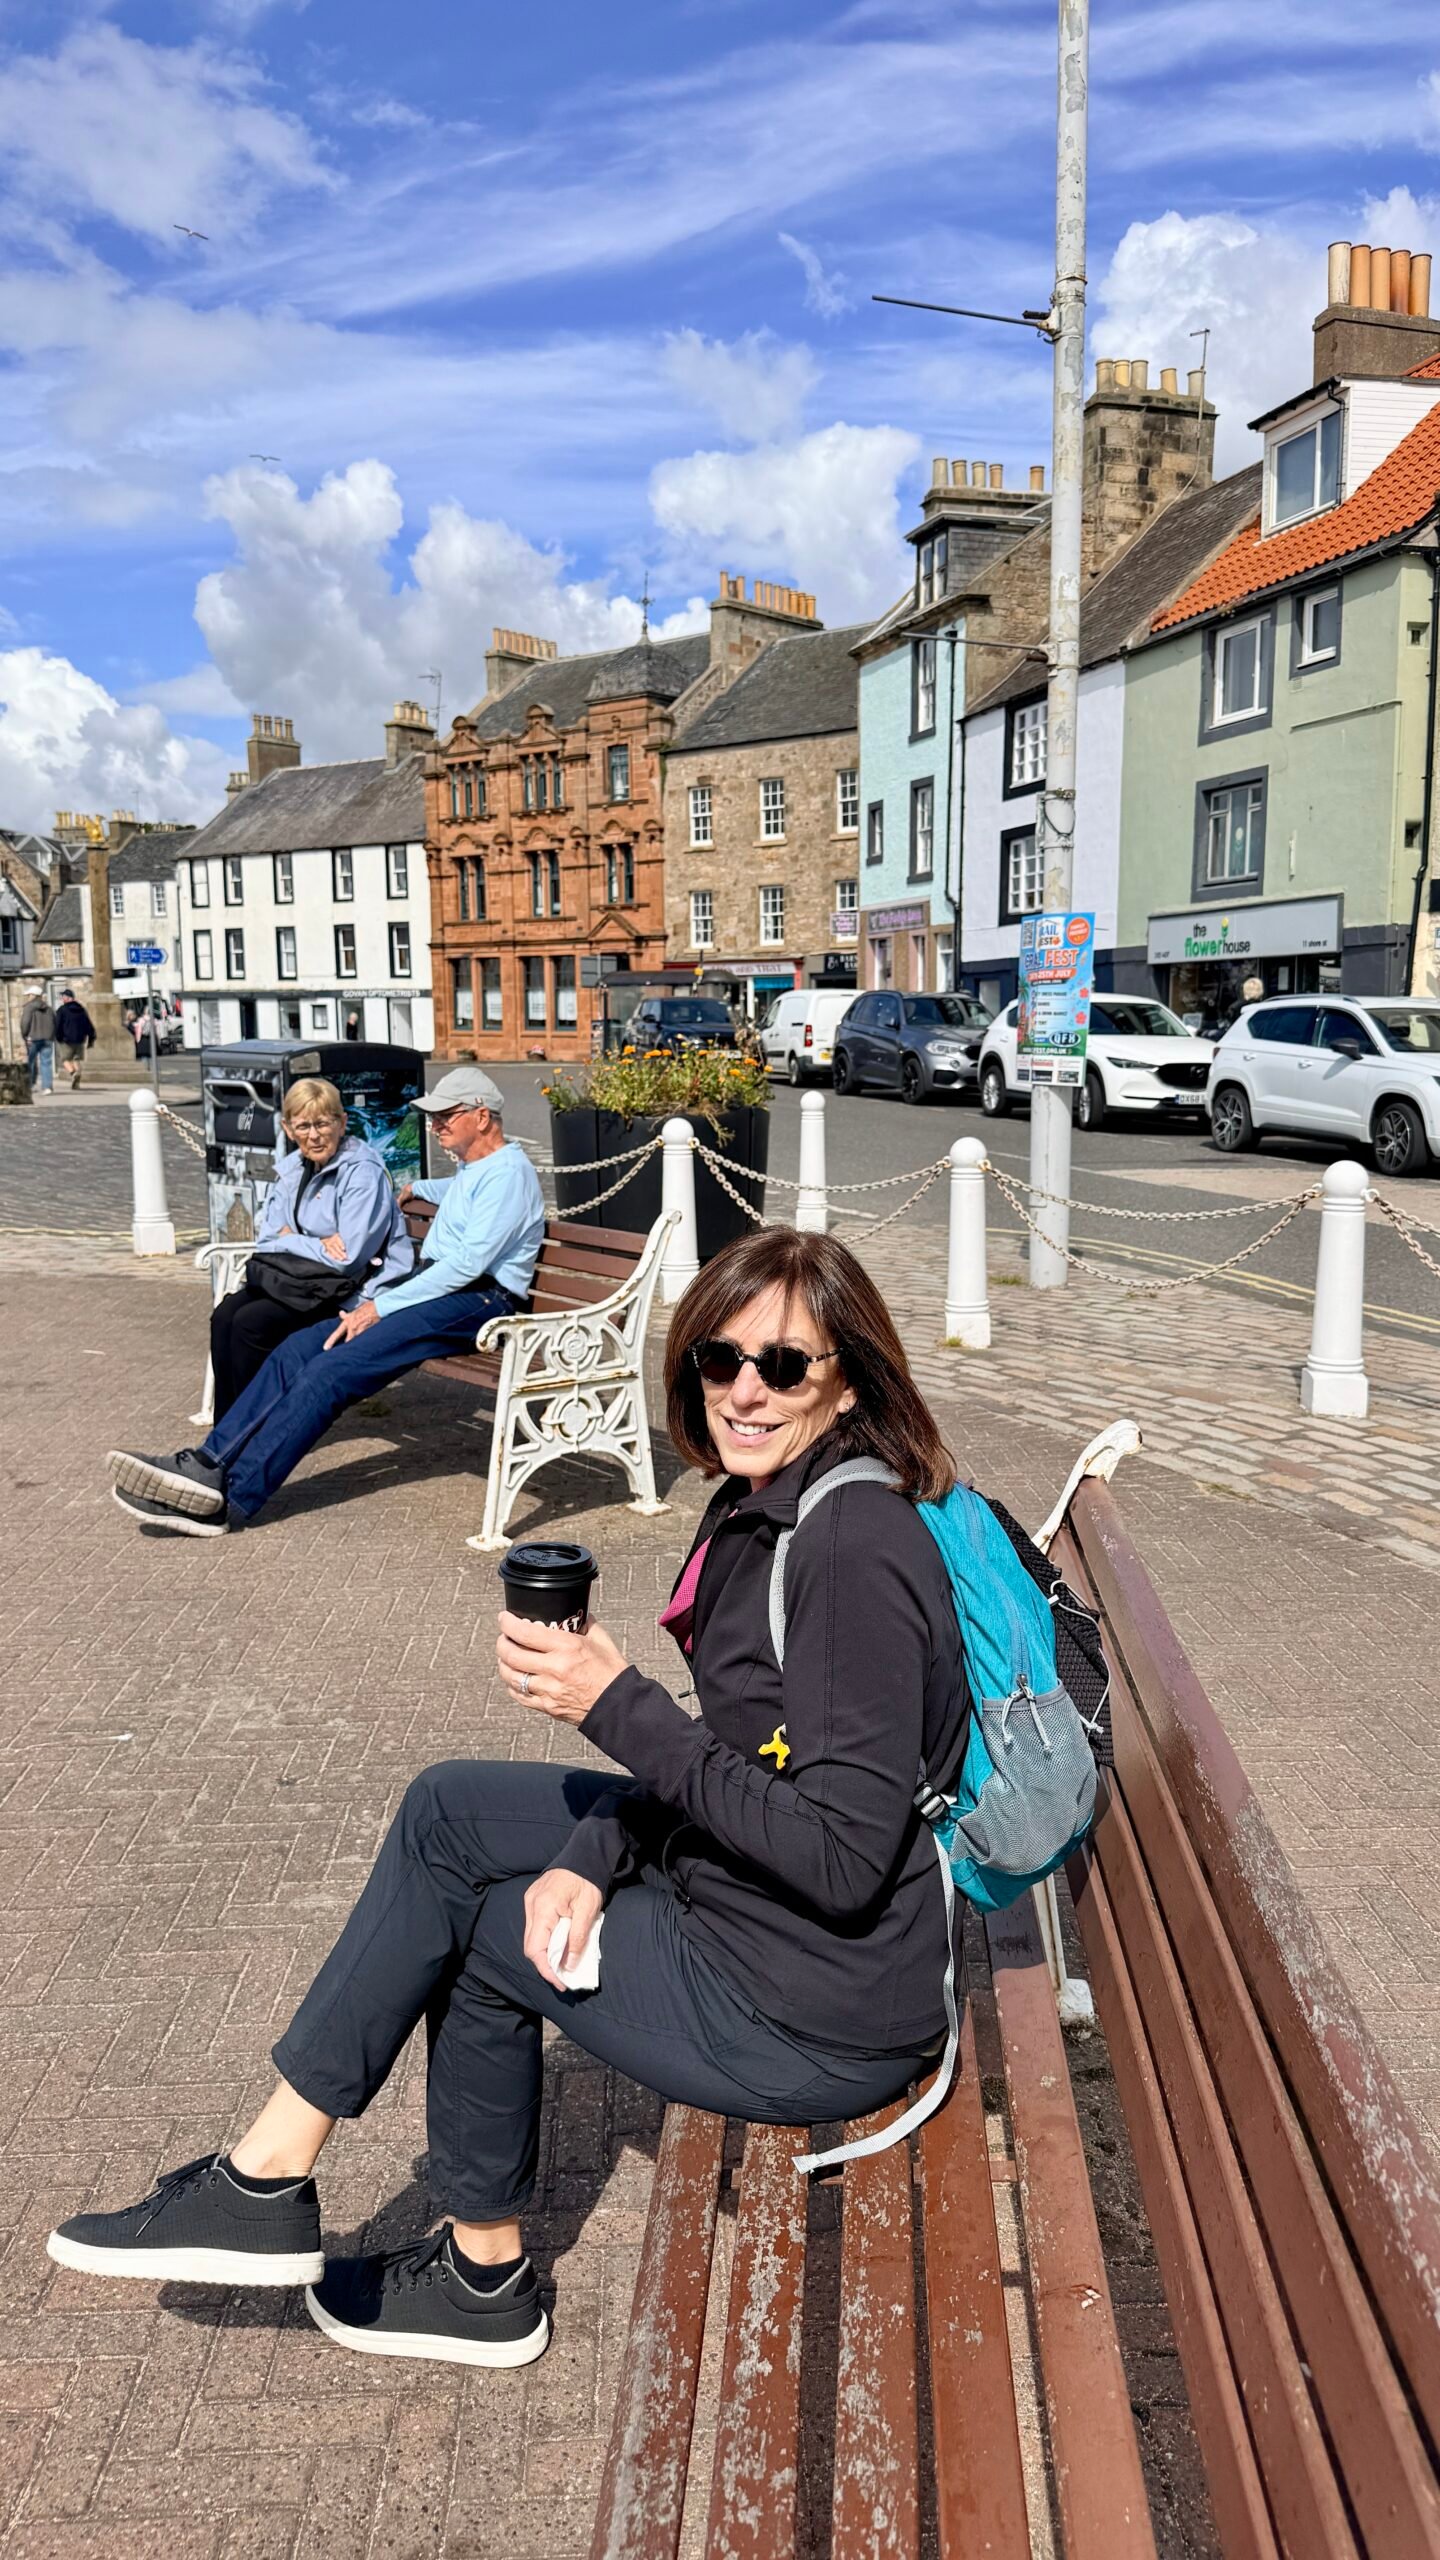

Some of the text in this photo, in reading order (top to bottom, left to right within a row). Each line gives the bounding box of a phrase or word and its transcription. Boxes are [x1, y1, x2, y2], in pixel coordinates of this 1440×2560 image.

[1193, 923, 1207, 938] the
[1045, 949, 1079, 966] FEST
[1054, 968, 1073, 978] JULY
[342, 990, 367, 998] GOVAN
